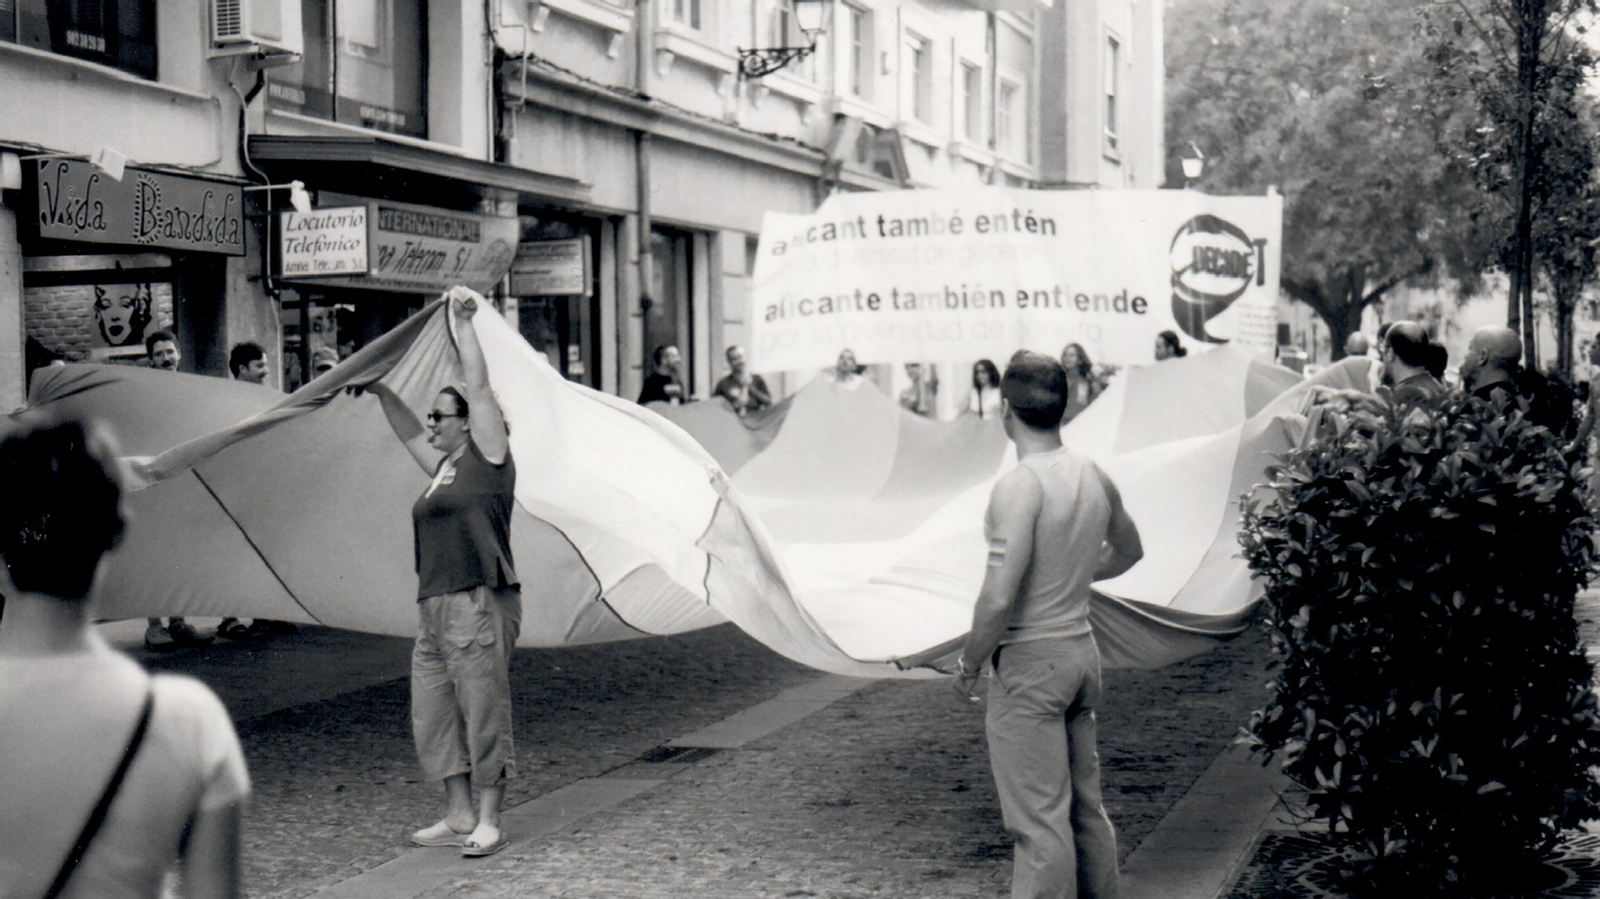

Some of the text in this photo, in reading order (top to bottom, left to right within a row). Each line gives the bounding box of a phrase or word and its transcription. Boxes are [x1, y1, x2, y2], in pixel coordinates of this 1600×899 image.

[42, 161, 242, 246] Vida Bandida
[286, 209, 364, 232] Locutorio
[876, 208, 963, 239] també
[975, 208, 1058, 237] entén
[764, 284, 1149, 323] alicante también entiende
